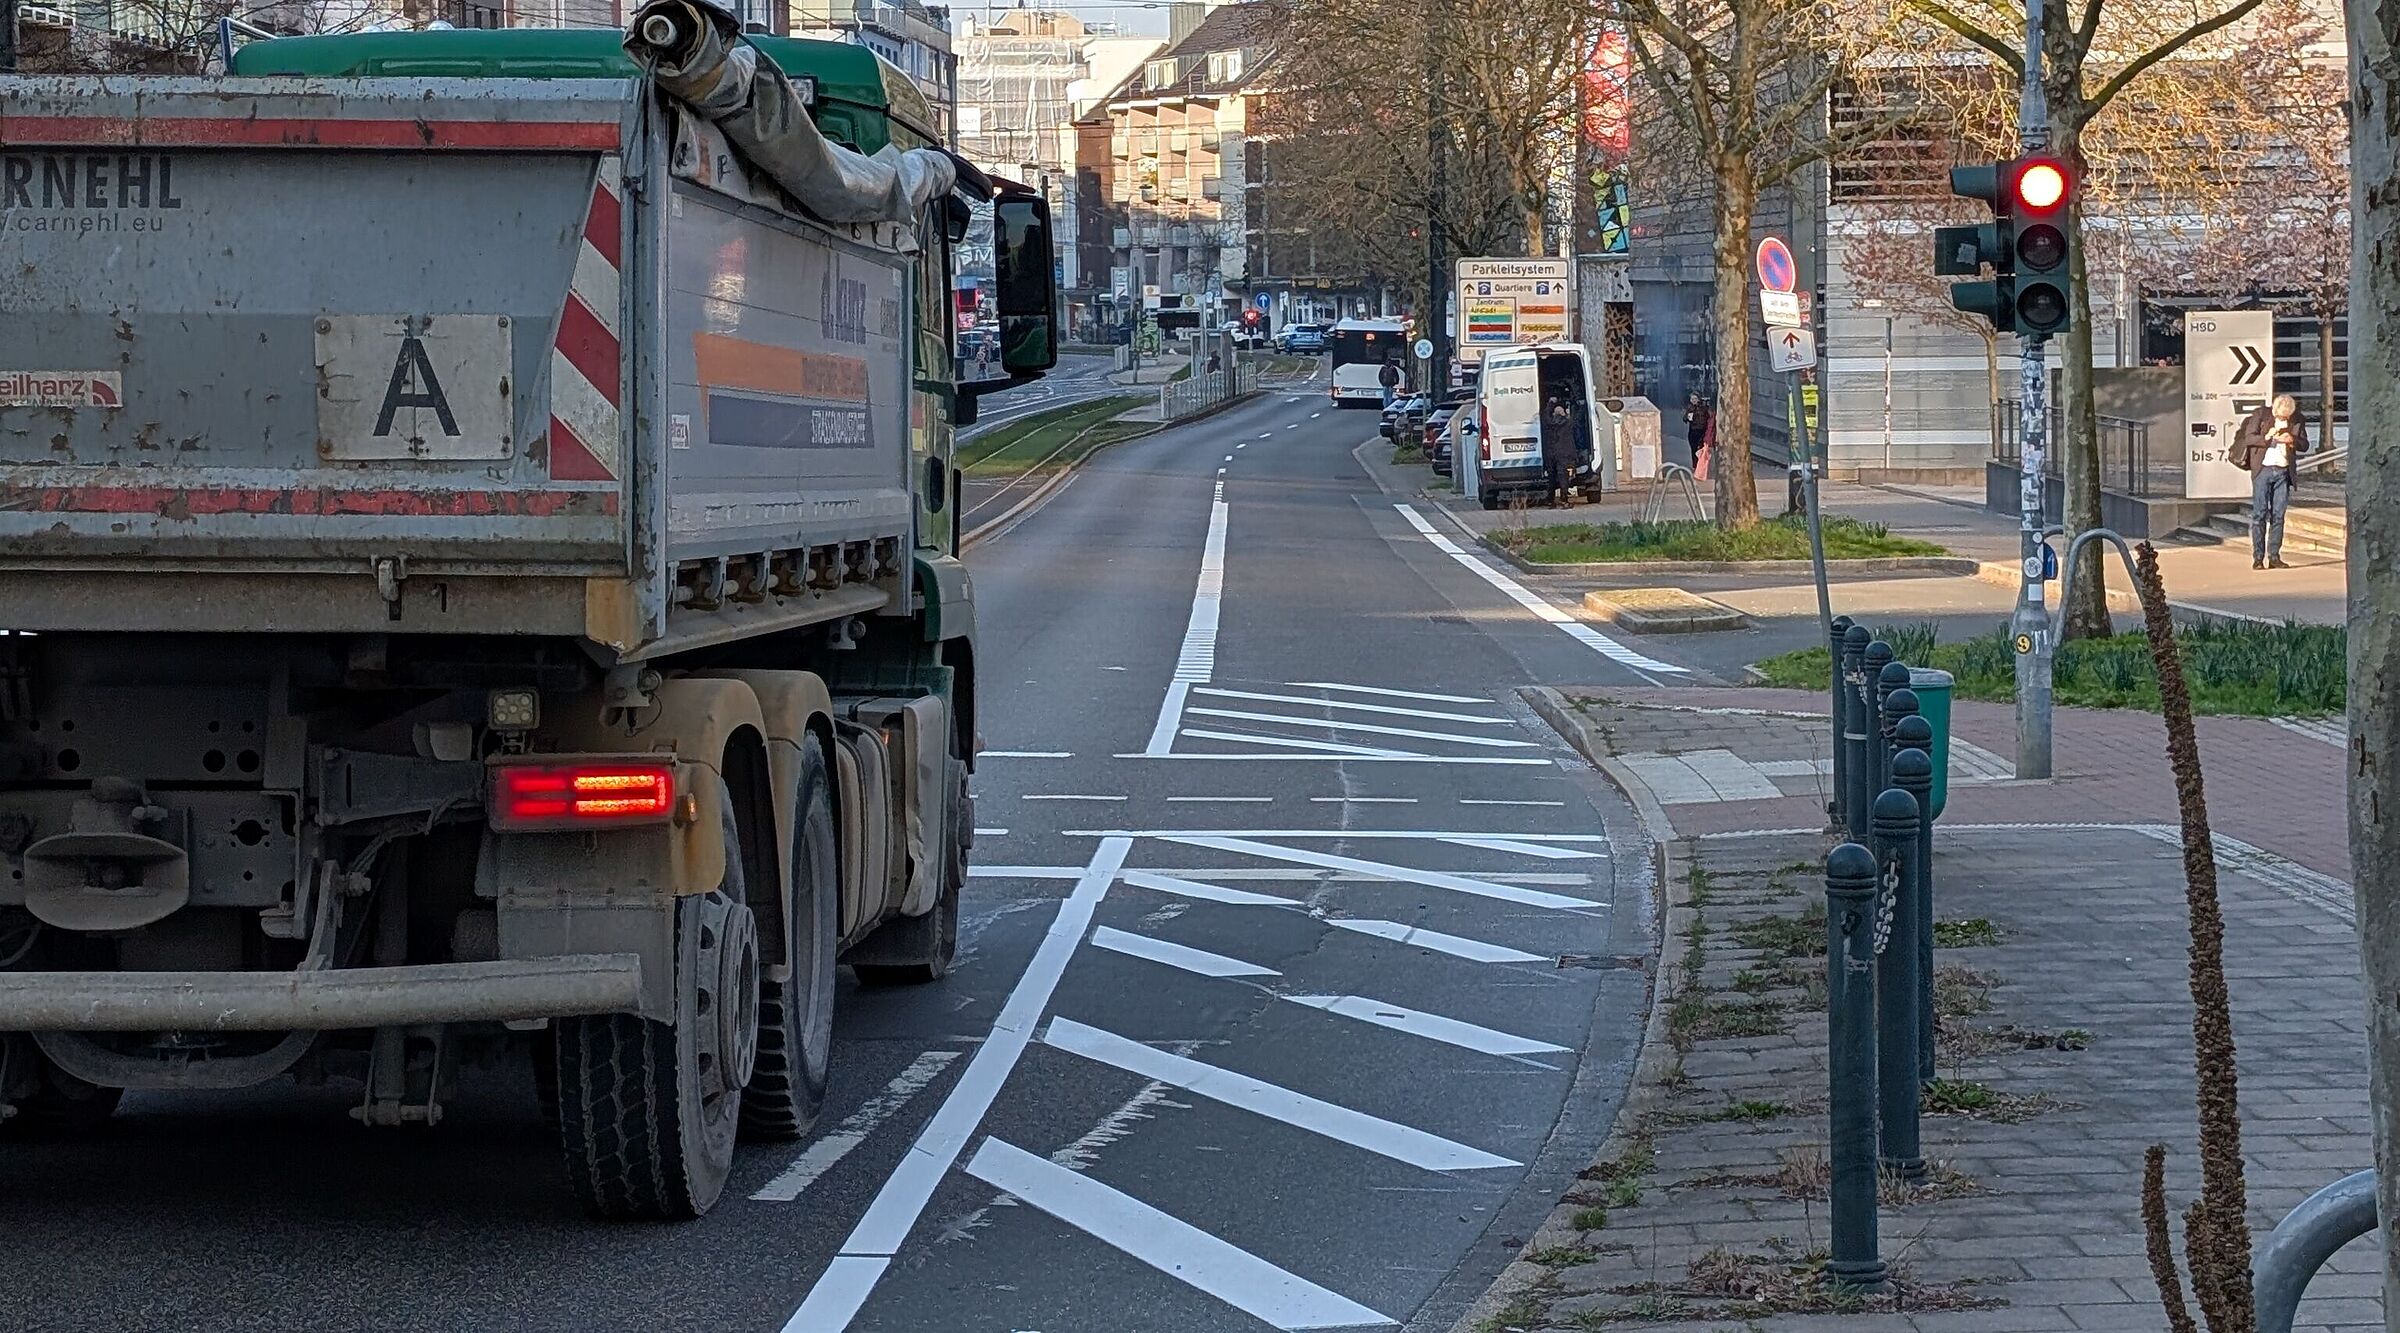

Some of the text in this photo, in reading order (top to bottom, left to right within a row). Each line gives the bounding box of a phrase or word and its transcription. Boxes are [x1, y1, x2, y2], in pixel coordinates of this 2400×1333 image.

[1472, 264, 1554, 276] Parkleitsystem
[1494, 284, 1532, 292] Quartiere
[2190, 322, 2216, 333] HSD
[373, 338, 462, 436] A
[2192, 449, 2214, 462] bis
